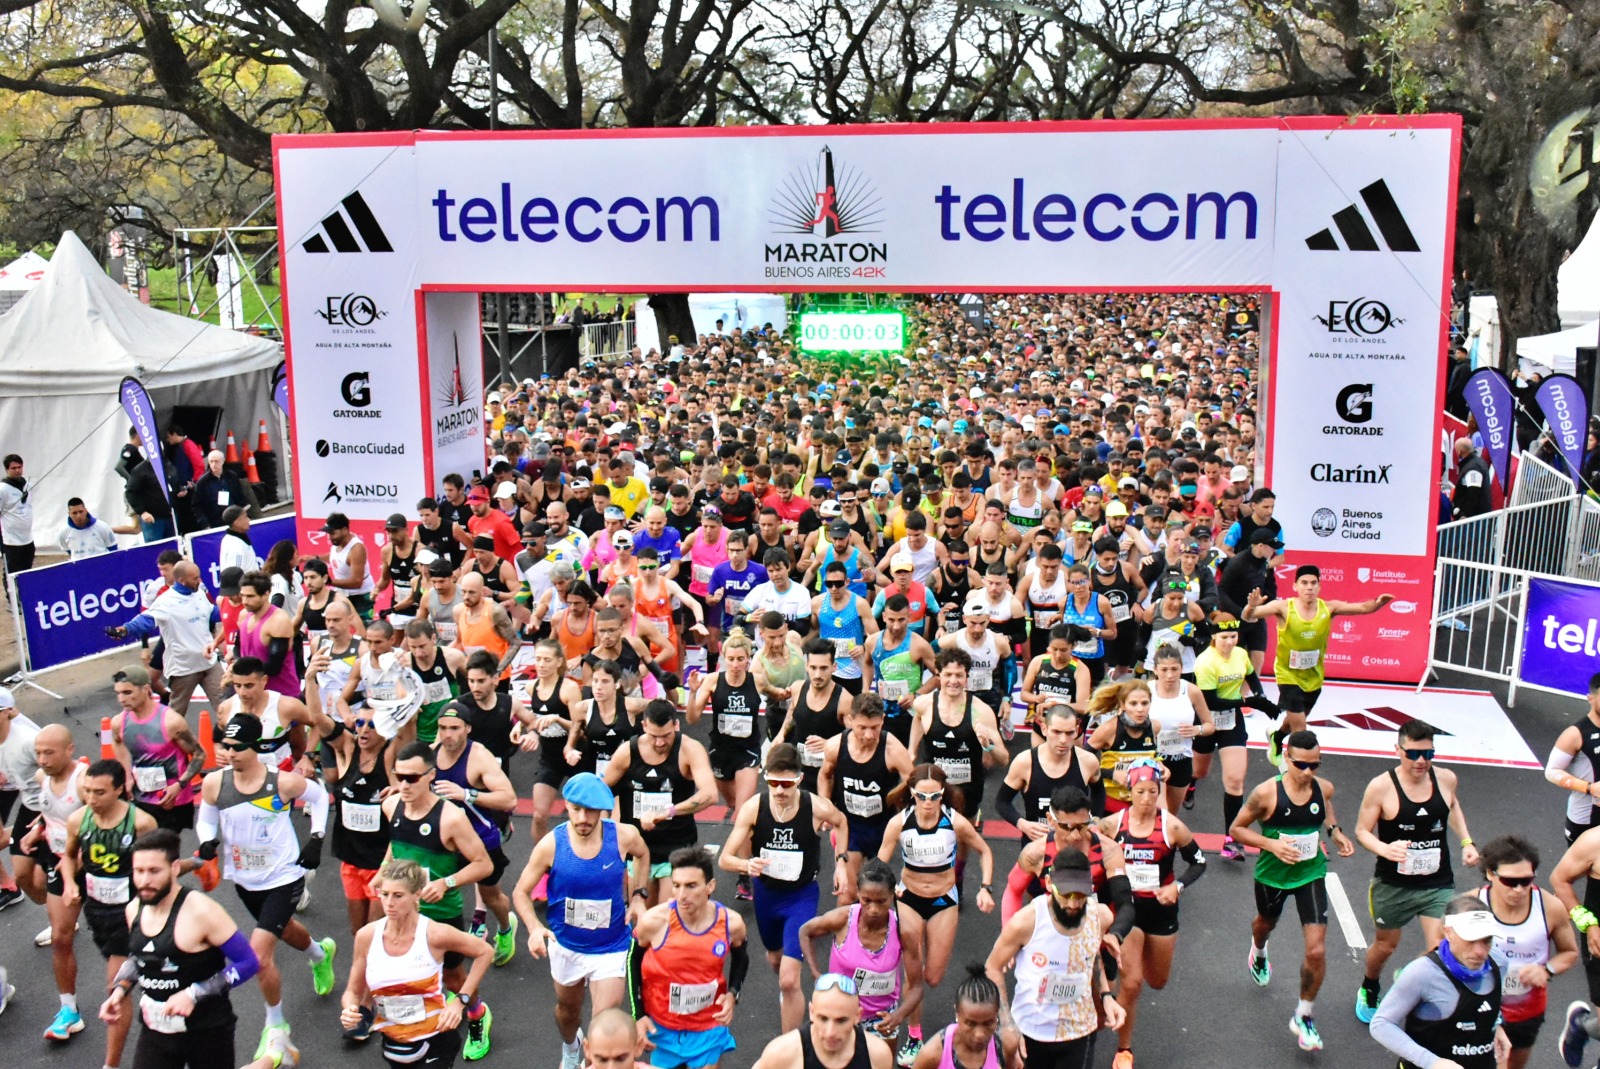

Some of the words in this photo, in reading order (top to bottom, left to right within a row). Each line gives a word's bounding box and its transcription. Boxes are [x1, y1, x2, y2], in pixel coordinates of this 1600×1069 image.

[432, 182, 720, 243] telecom
[935, 178, 1258, 242] telecom
[765, 243, 887, 263] MARATON
[765, 267, 814, 278] BUENOS
[817, 267, 851, 278] AIRES
[852, 267, 886, 278] 42K
[805, 324, 899, 340] 00:00:03
[333, 409, 382, 418] GATORADE
[437, 406, 479, 435] MARATON
[1322, 425, 1384, 436] GATORADE
[332, 442, 405, 455] BancoCiudad
[1310, 463, 1378, 484] Clarín
[1342, 508, 1383, 519] Buenos
[1341, 519, 1372, 529] Aires
[1341, 529, 1381, 540] Ciudad
[725, 580, 751, 590] FILA
[1543, 615, 1600, 658] tel
[1218, 672, 1243, 683] BRASIL
[1038, 682, 1070, 695] BOLIVIA
[728, 695, 746, 708] M
[843, 776, 881, 793] FILA
[773, 828, 794, 843] M
[765, 842, 799, 850] MALGOR
[1451, 1042, 1495, 1056] teleco
